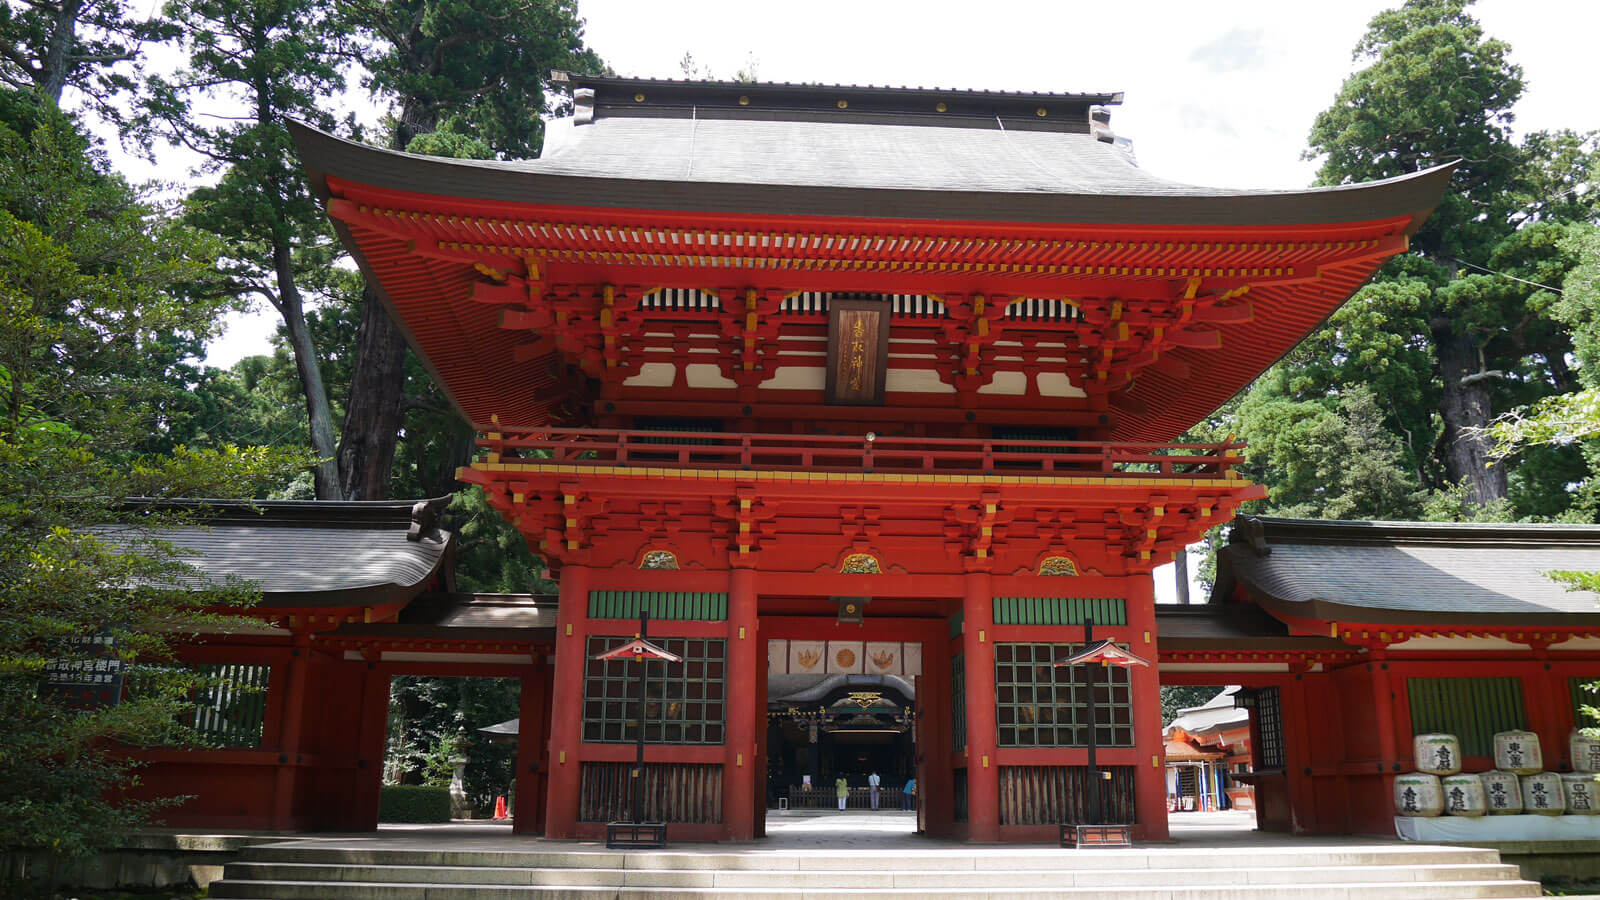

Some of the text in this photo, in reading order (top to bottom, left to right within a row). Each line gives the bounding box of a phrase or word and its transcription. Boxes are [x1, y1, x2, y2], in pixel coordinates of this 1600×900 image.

[46, 658, 120, 672] 香取神宮楼門
